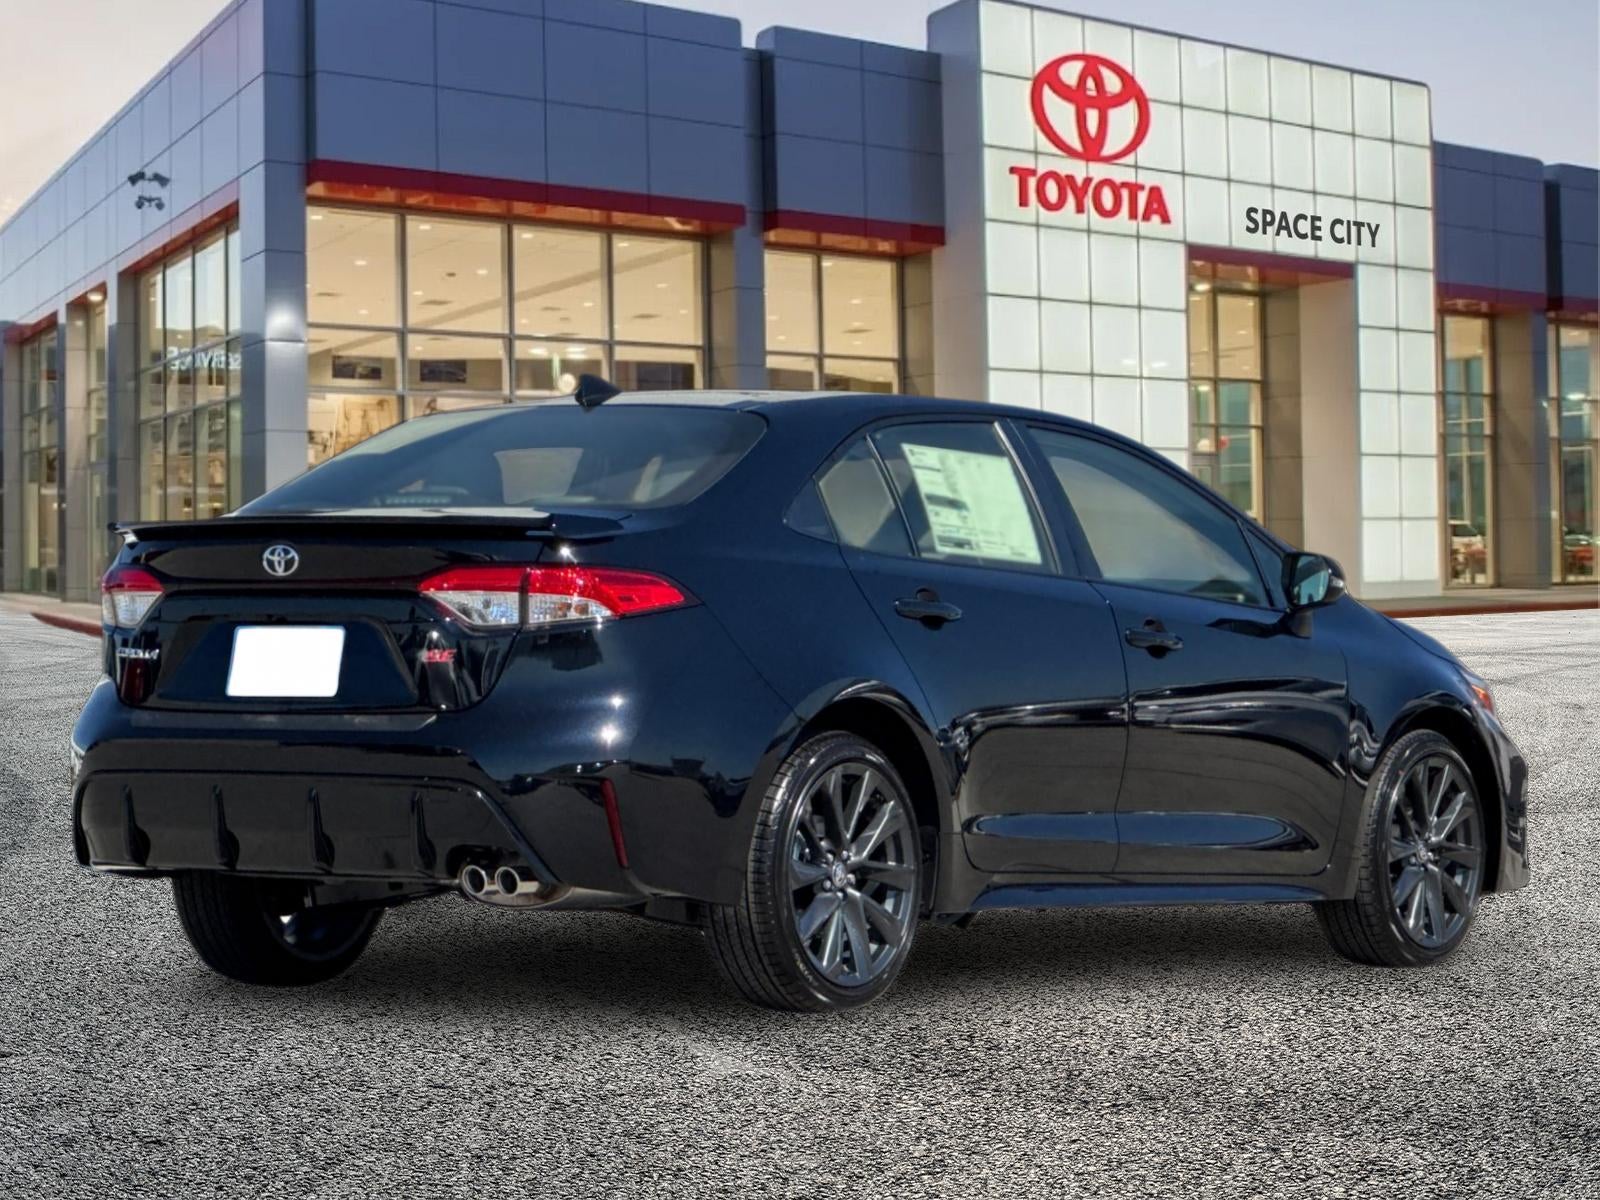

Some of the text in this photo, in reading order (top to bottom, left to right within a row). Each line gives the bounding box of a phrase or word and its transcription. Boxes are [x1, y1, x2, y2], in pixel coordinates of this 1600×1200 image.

[1009, 166, 1172, 225] TOYOTA
[1245, 206, 1381, 248] SPACE CITY
